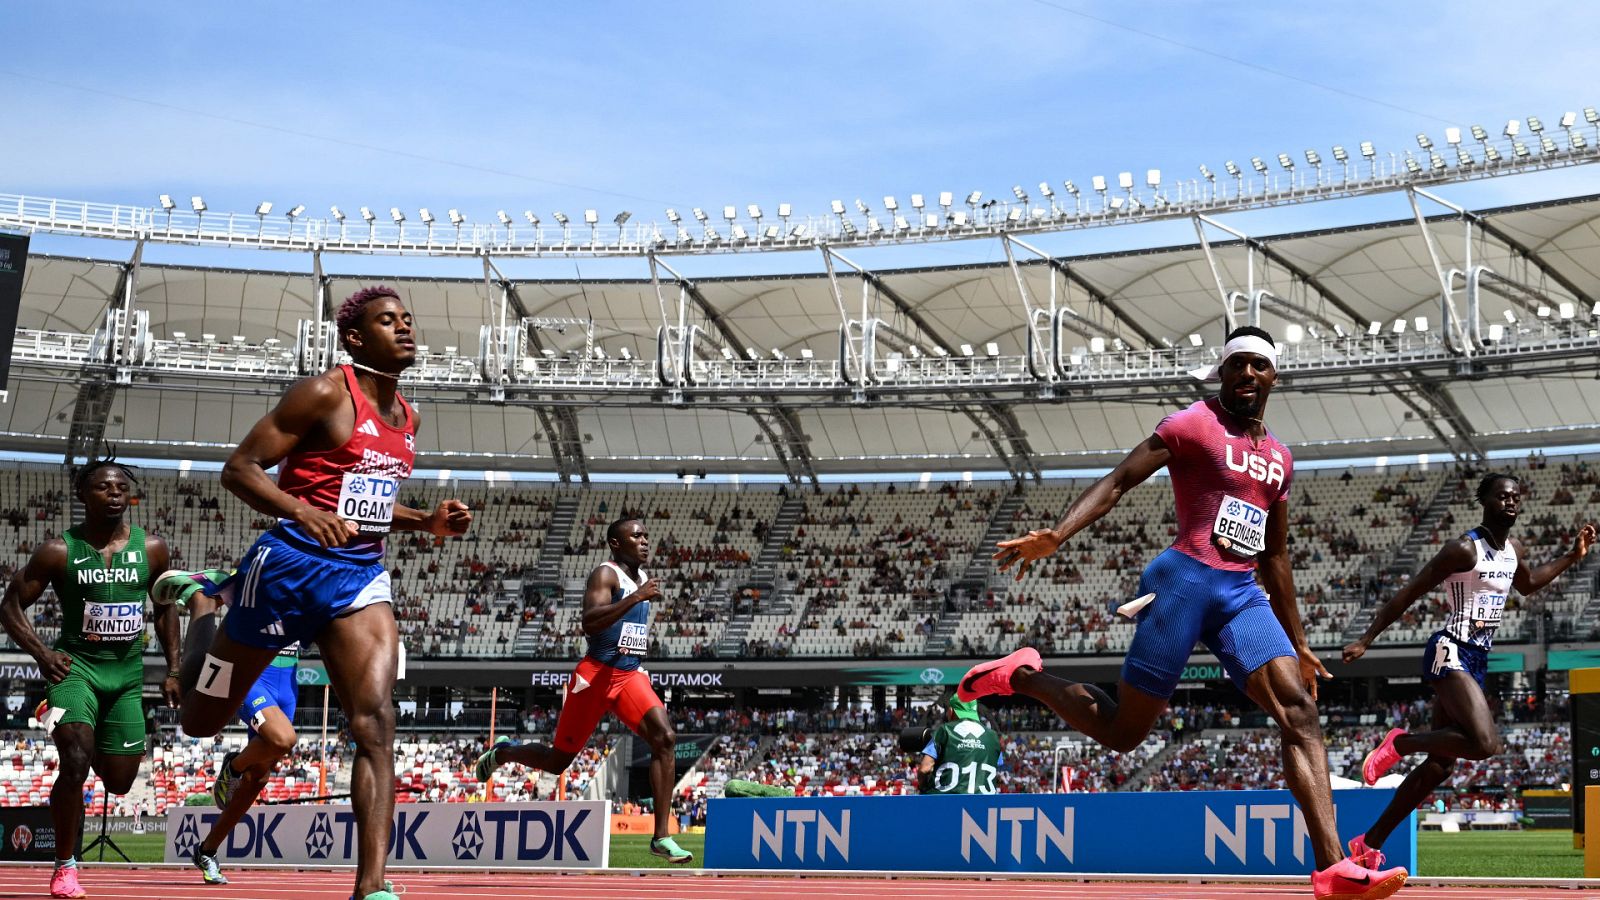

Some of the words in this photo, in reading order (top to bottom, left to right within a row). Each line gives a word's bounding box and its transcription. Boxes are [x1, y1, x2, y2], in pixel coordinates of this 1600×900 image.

[1226, 444, 1285, 490] USA
[77, 568, 139, 585] NIGERIA
[1479, 571, 1514, 580] FRANC
[103, 604, 143, 617] TDK
[1489, 608, 1502, 619] ZEZ
[634, 625, 646, 636] TD
[621, 635, 646, 648] EDWAR
[1442, 646, 1451, 662] 2
[0, 665, 41, 679] TAM
[205, 662, 221, 689] 7
[532, 670, 572, 686] FÉRFI
[651, 673, 722, 686] FUTAMOK
[1180, 666, 1220, 679] 200M
[935, 761, 996, 794] 013
[335, 811, 430, 860] TK
[485, 809, 591, 861] TDK
[752, 809, 850, 863] NTN
[961, 806, 1075, 865] NTN
